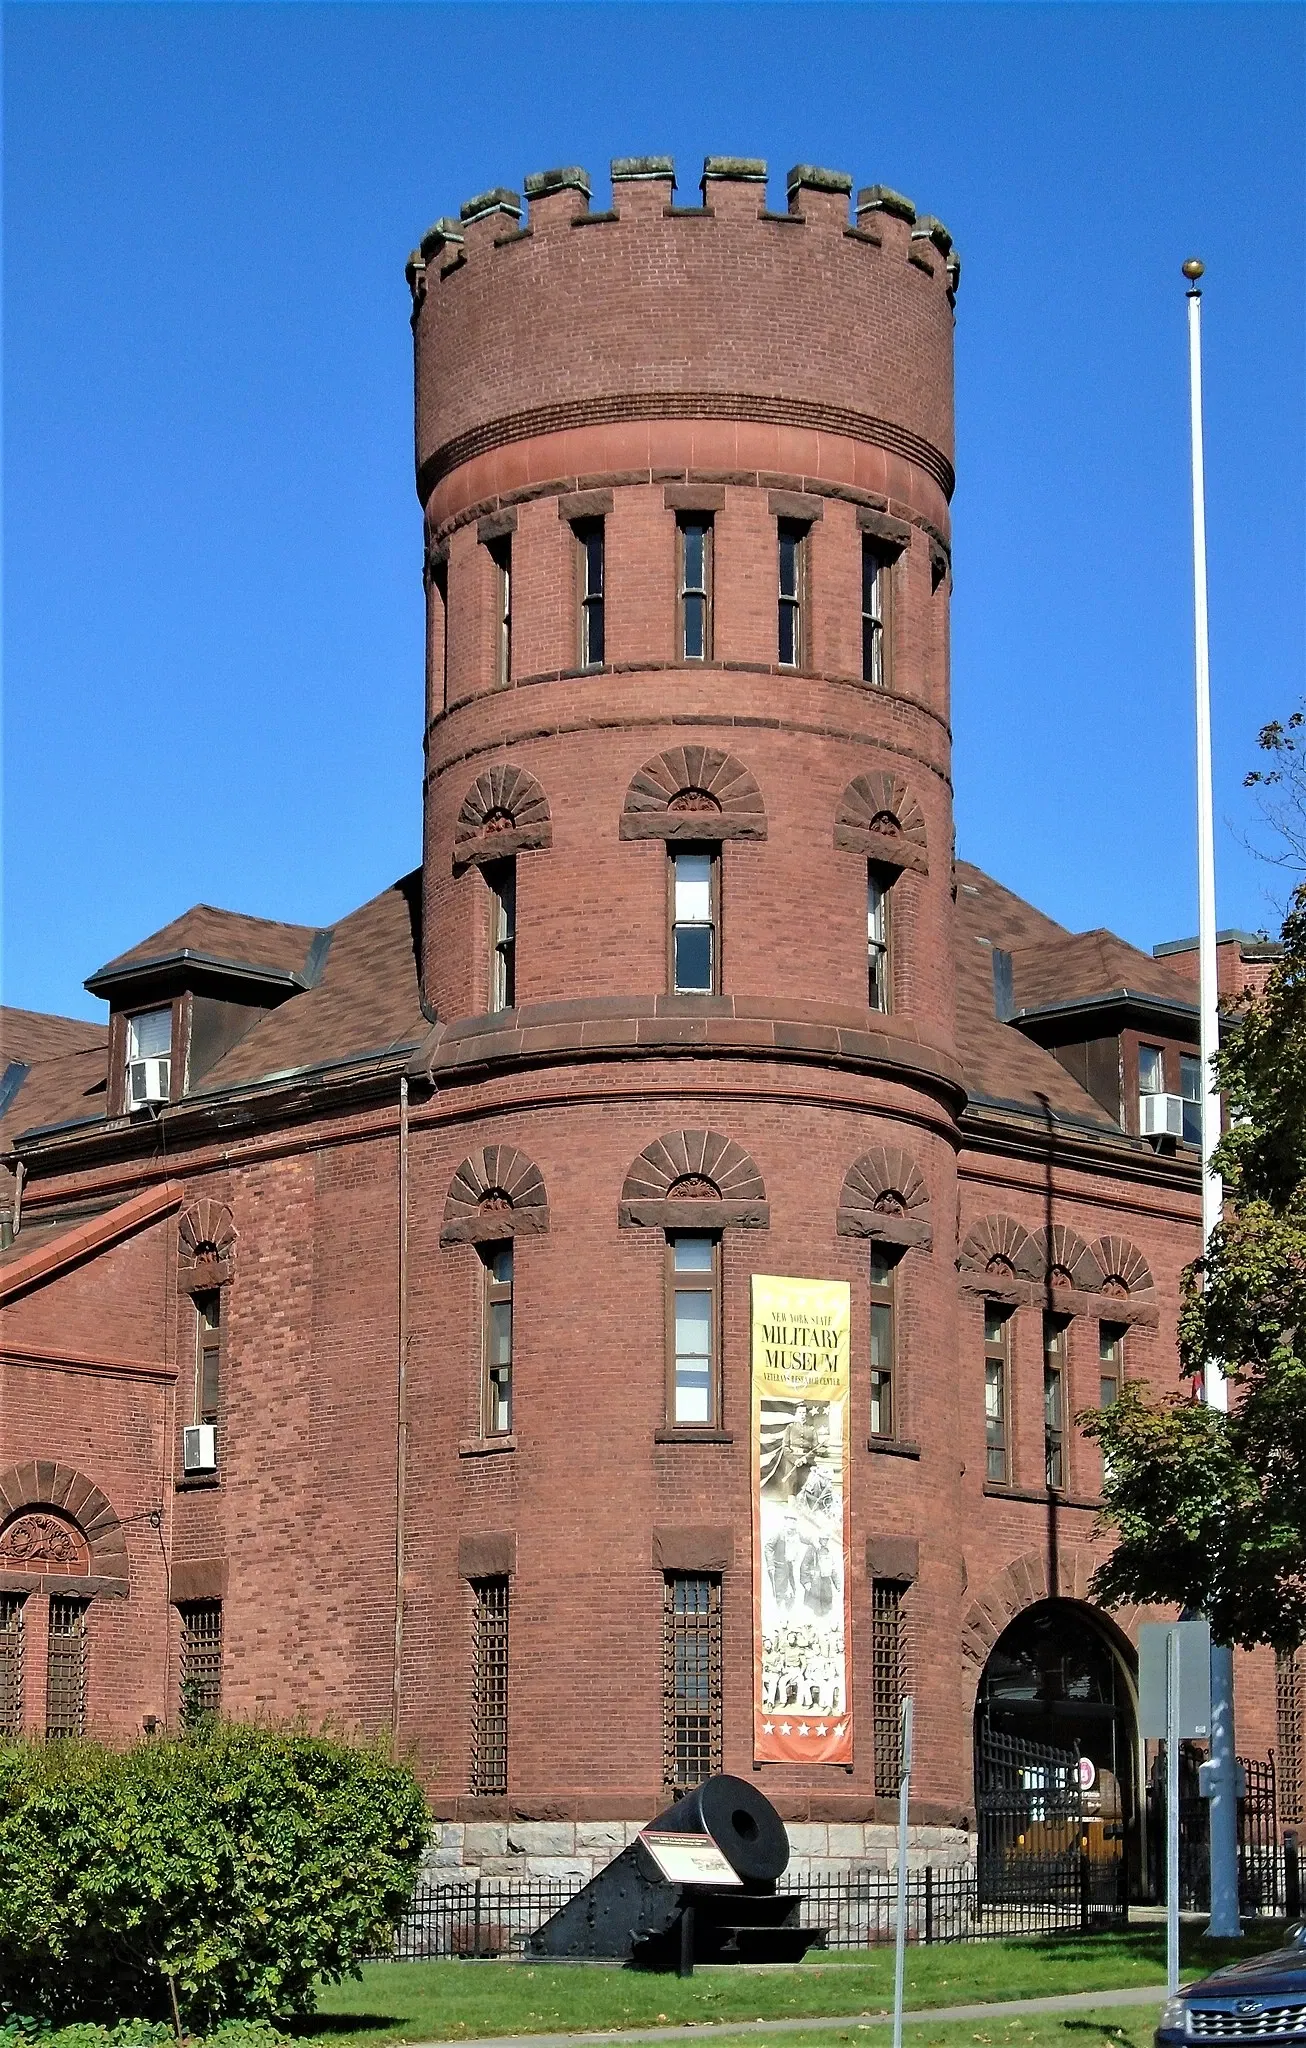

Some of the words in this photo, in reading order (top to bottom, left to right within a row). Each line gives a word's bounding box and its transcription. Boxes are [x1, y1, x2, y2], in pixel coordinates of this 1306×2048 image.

[772, 1312, 786, 1322] NEW
[790, 1314, 808, 1324] YORK
[811, 1316, 831, 1326] STATE
[761, 1325, 841, 1348] MILITARY
[765, 1349, 839, 1372] MUSEUM
[763, 1372, 790, 1382] VETERANS
[820, 1377, 840, 1386] CENTER
